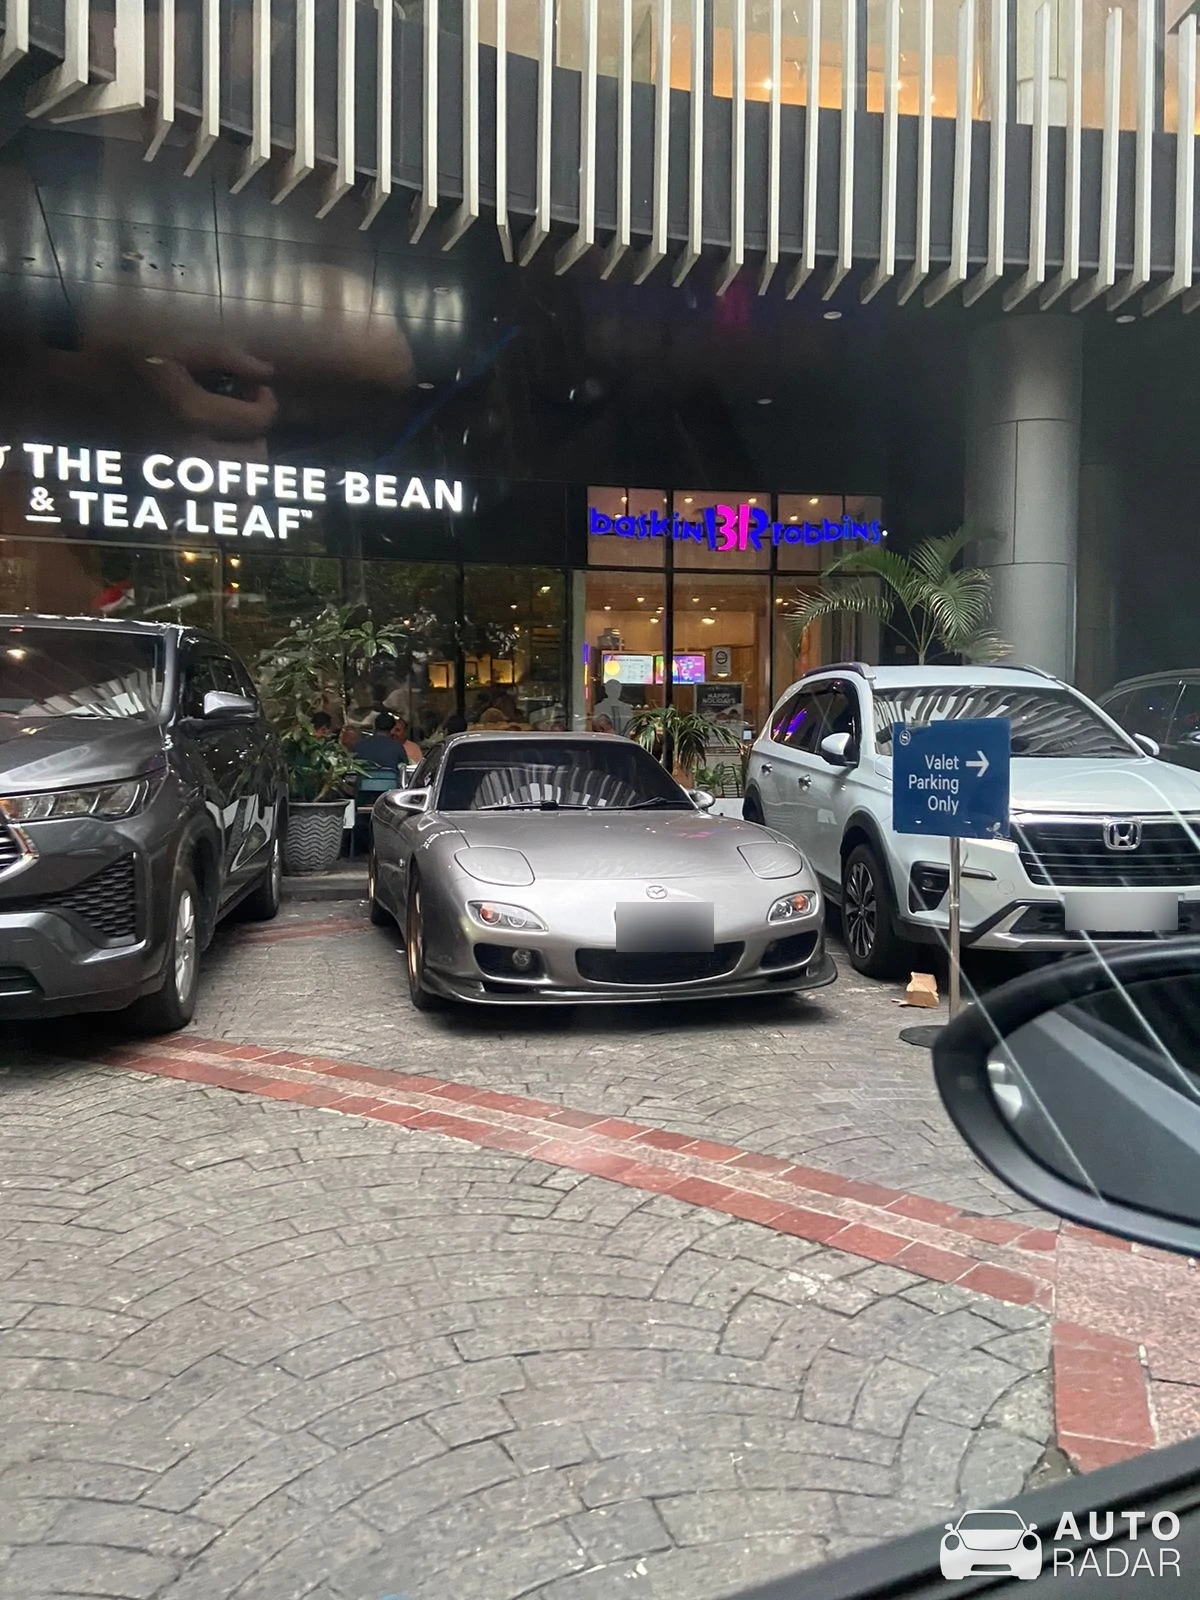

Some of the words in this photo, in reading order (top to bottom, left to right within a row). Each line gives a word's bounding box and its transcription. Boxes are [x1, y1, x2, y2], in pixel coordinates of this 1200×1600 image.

[23, 443, 123, 484] THE
[142, 454, 326, 502] COFFEE
[344, 472, 463, 512] BEAN
[29, 486, 55, 512] &
[69, 490, 168, 530] TEA
[589, 507, 703, 544] baskin
[772, 515, 882, 546] robbins
[925, 754, 960, 770] Valet
[908, 774, 960, 795] Parking
[927, 795, 960, 816] Only
